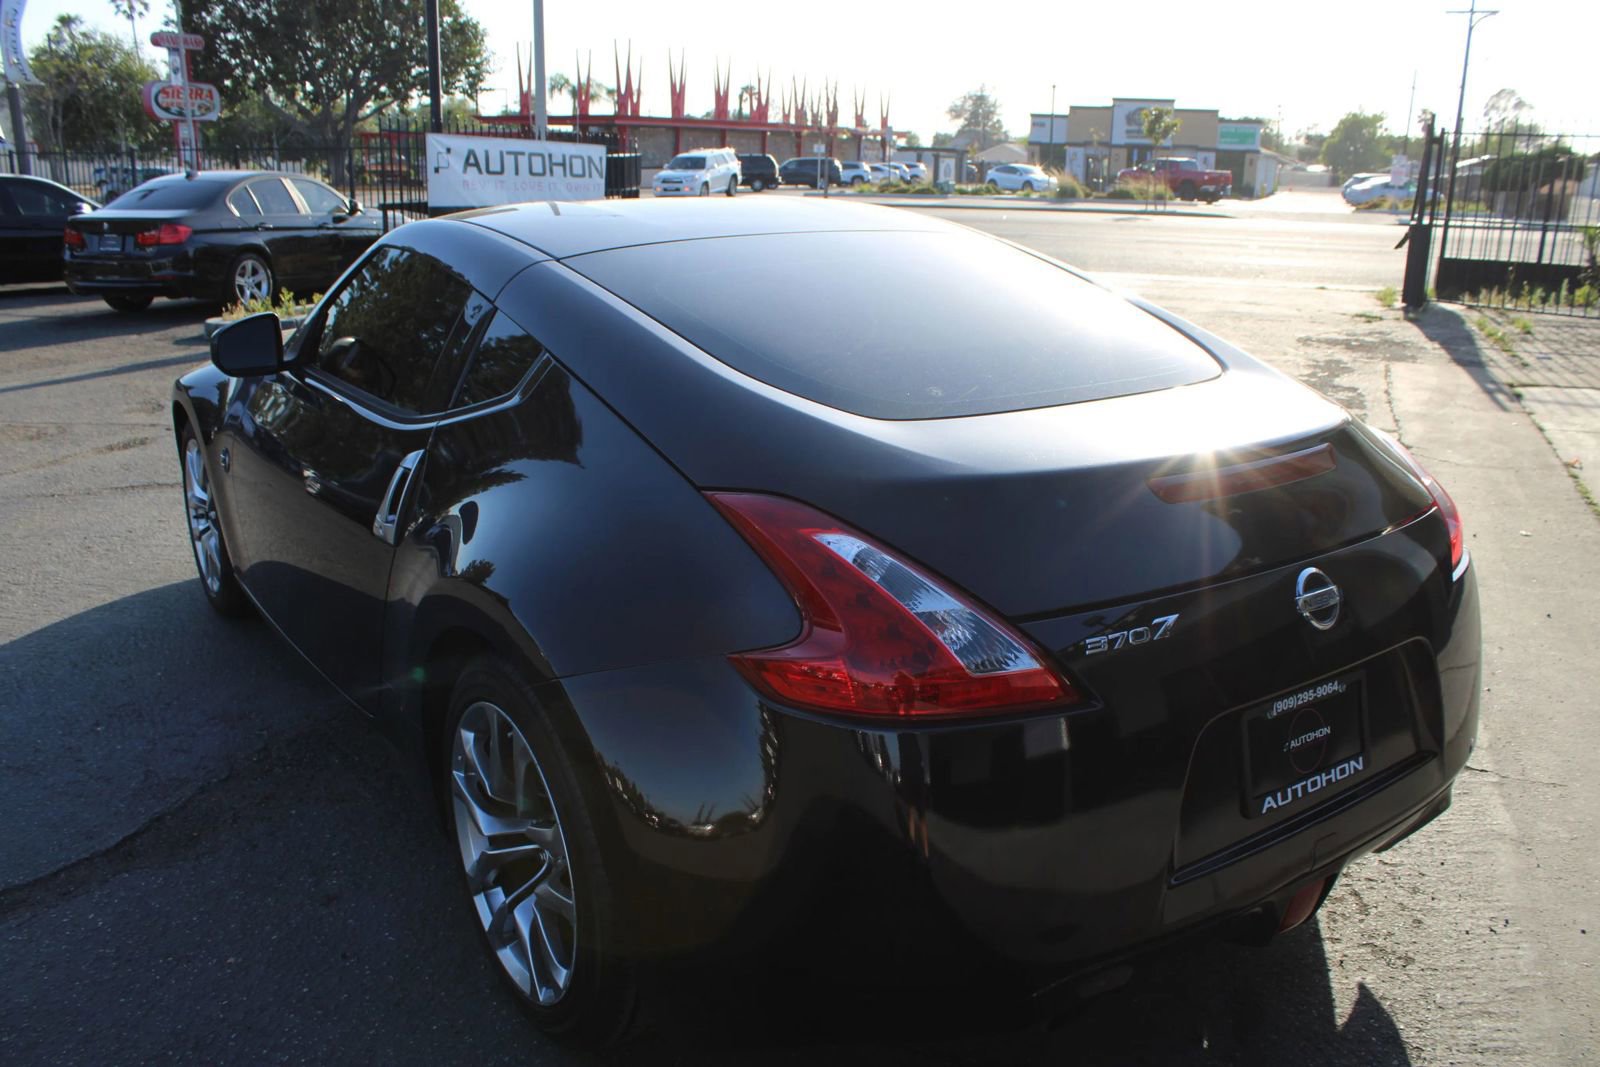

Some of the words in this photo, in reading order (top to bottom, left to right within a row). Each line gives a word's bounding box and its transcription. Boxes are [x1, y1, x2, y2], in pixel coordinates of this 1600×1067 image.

[159, 86, 214, 101] SIERRA
[462, 148, 604, 179] AUTOHON
[1273, 680, 1339, 716] (909)295-9064
[1290, 726, 1331, 749] AUTOHON
[1262, 756, 1364, 814] AUTOHON
